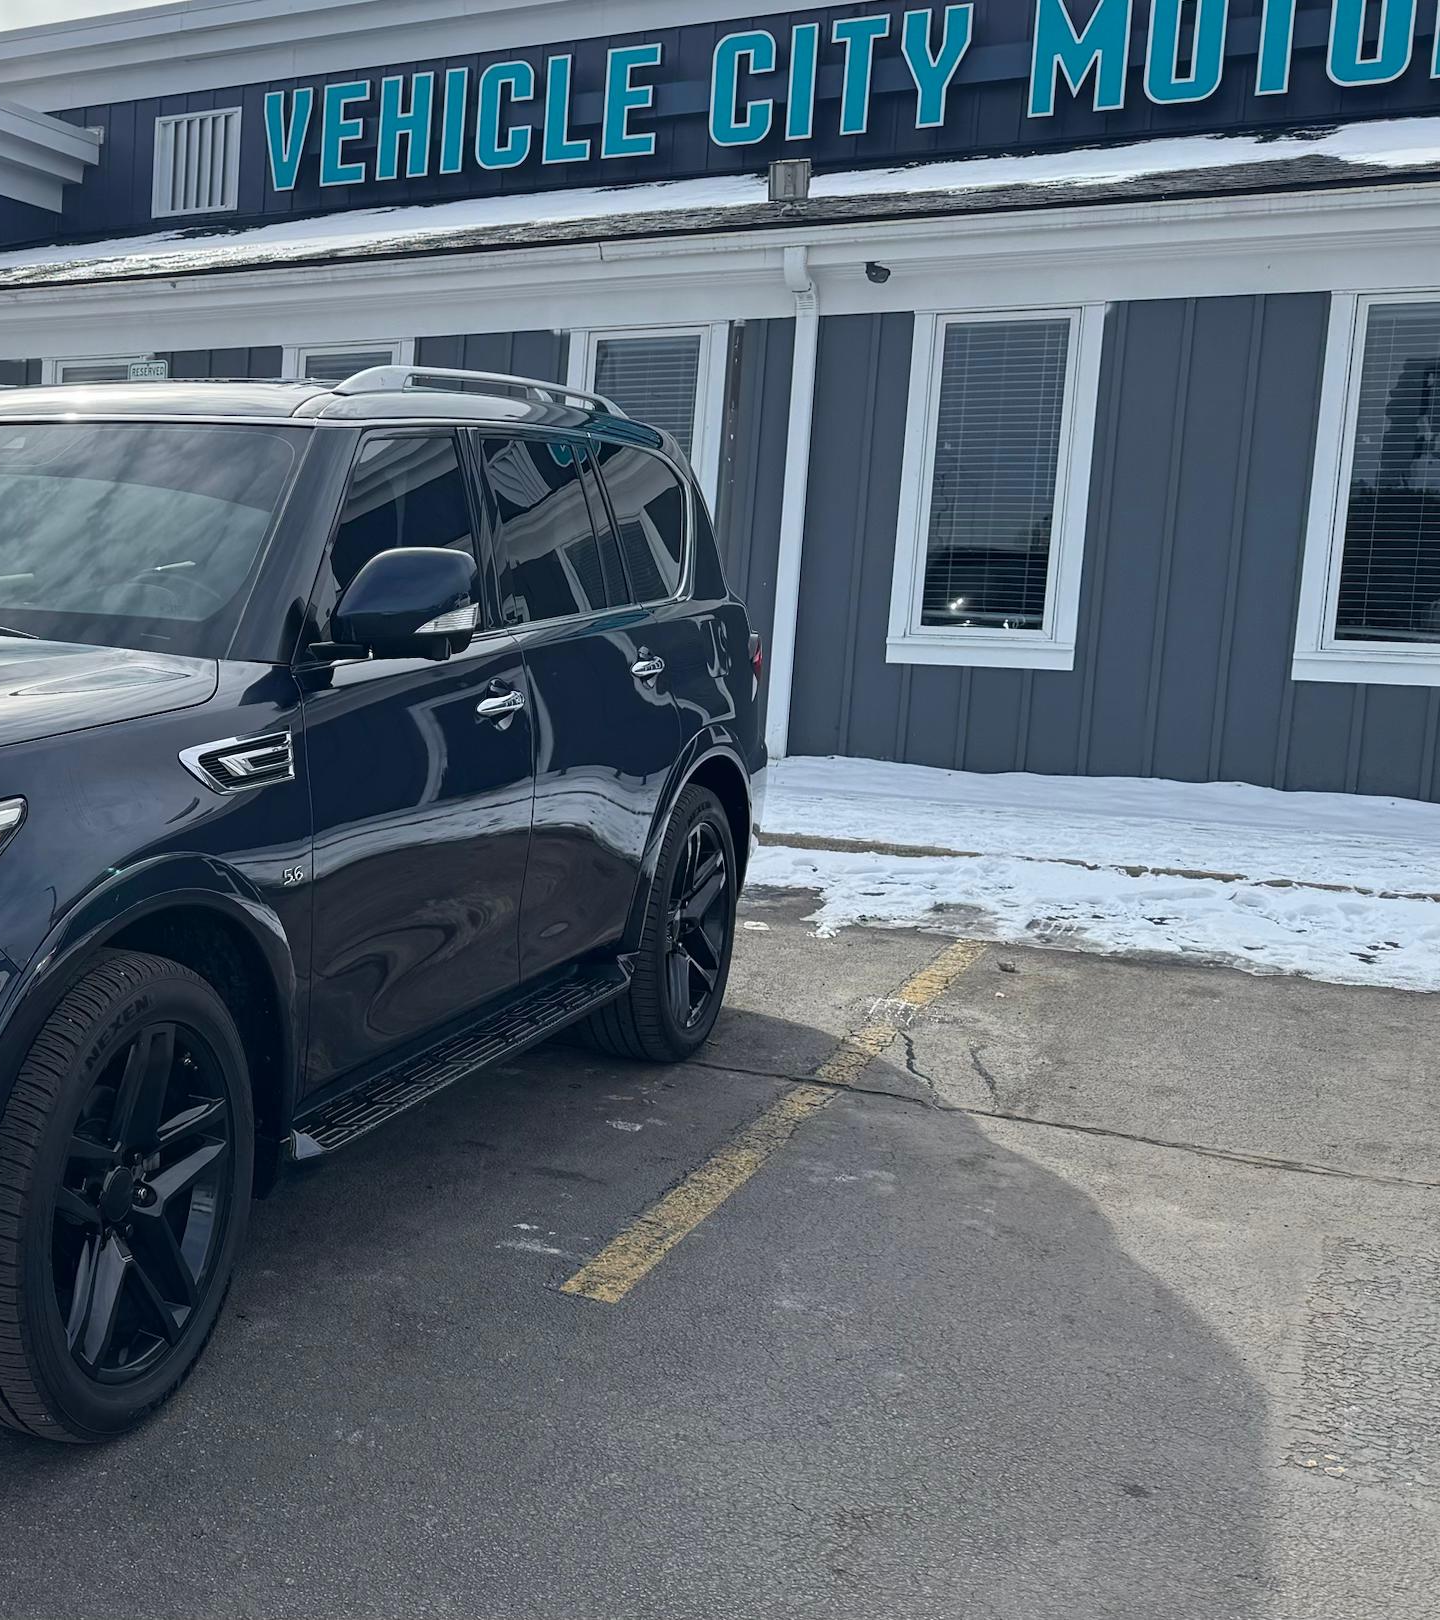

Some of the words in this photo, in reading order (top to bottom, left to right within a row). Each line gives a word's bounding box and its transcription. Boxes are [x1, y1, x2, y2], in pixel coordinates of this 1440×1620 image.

[264, 43, 662, 191] VEHICLE
[708, 2, 974, 147] CITY
[1027, 0, 1440, 118] MOTO
[131, 366, 164, 377] RESERVED
[283, 865, 304, 885] 5.6
[85, 994, 150, 1072] NEXEN
